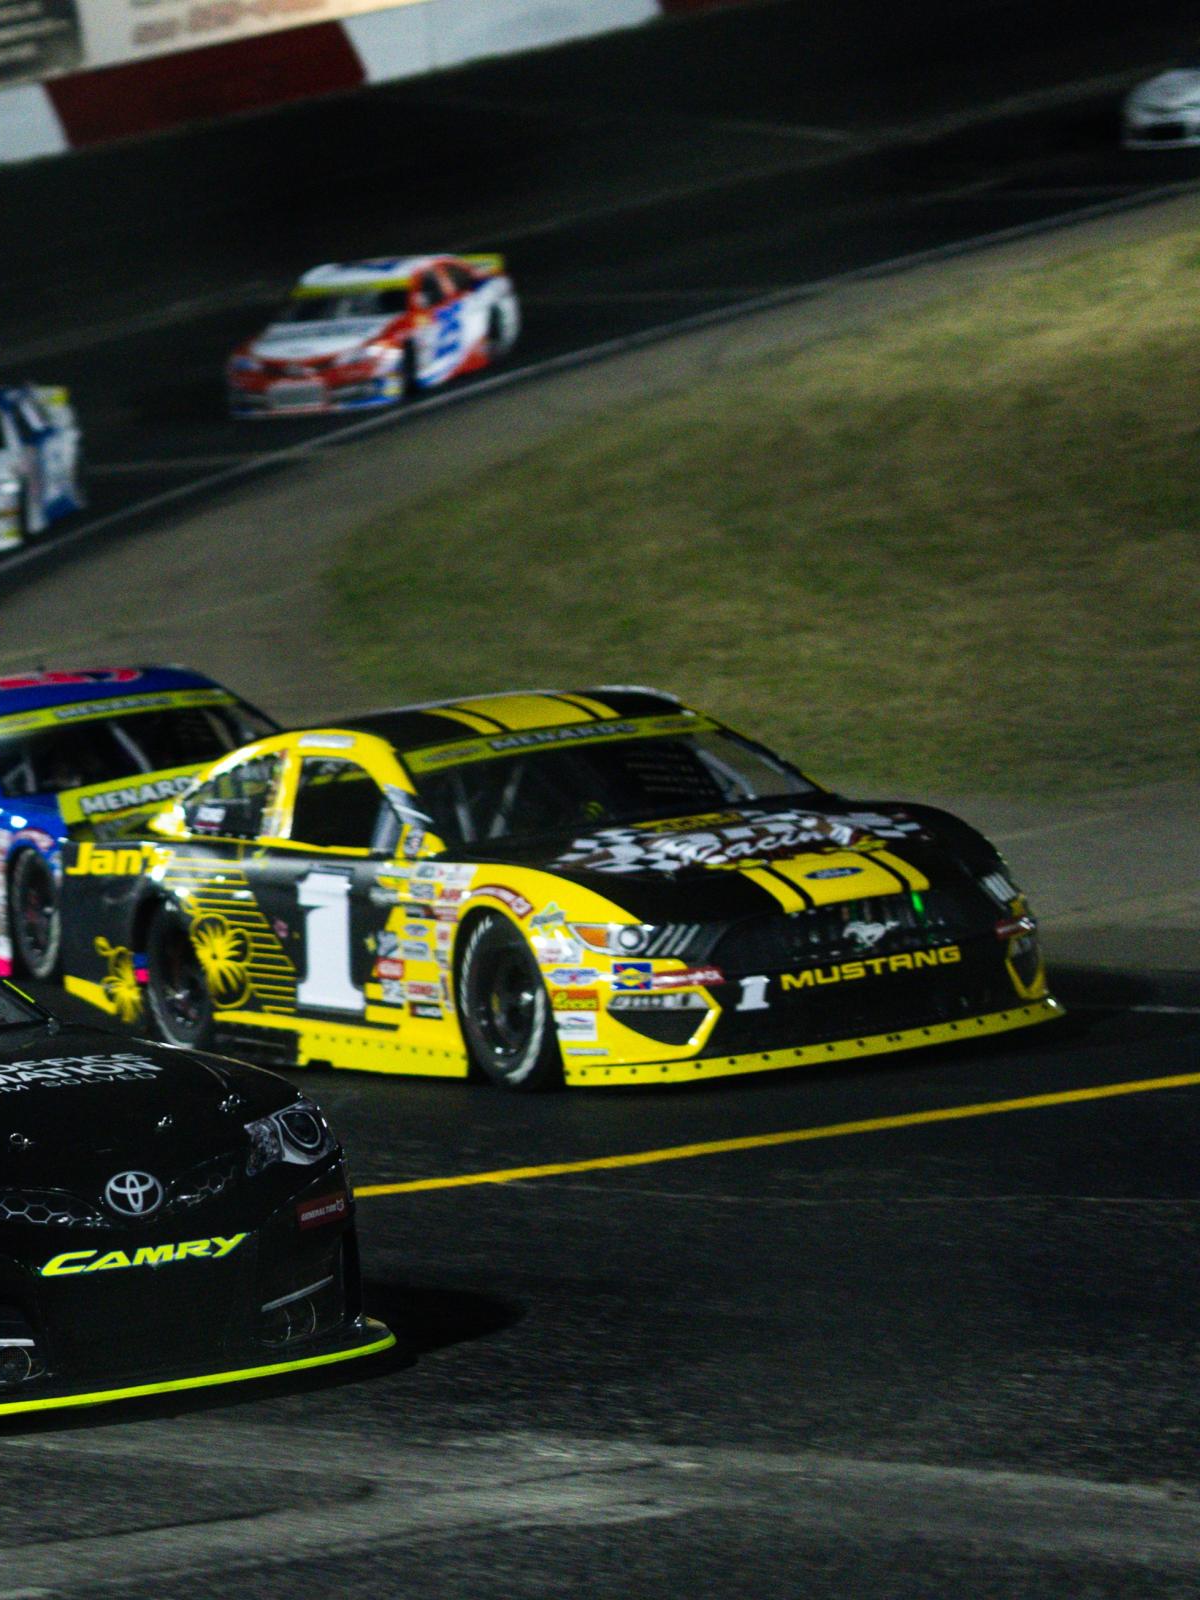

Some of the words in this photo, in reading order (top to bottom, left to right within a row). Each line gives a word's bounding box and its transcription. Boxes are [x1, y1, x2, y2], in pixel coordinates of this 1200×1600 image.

[297, 872, 366, 1011] 1
[781, 945, 961, 991] MUSTANG
[736, 975, 771, 1012] 1
[40, 1071, 157, 1087] SOLVED
[41, 1233, 250, 1276] CAMRY
